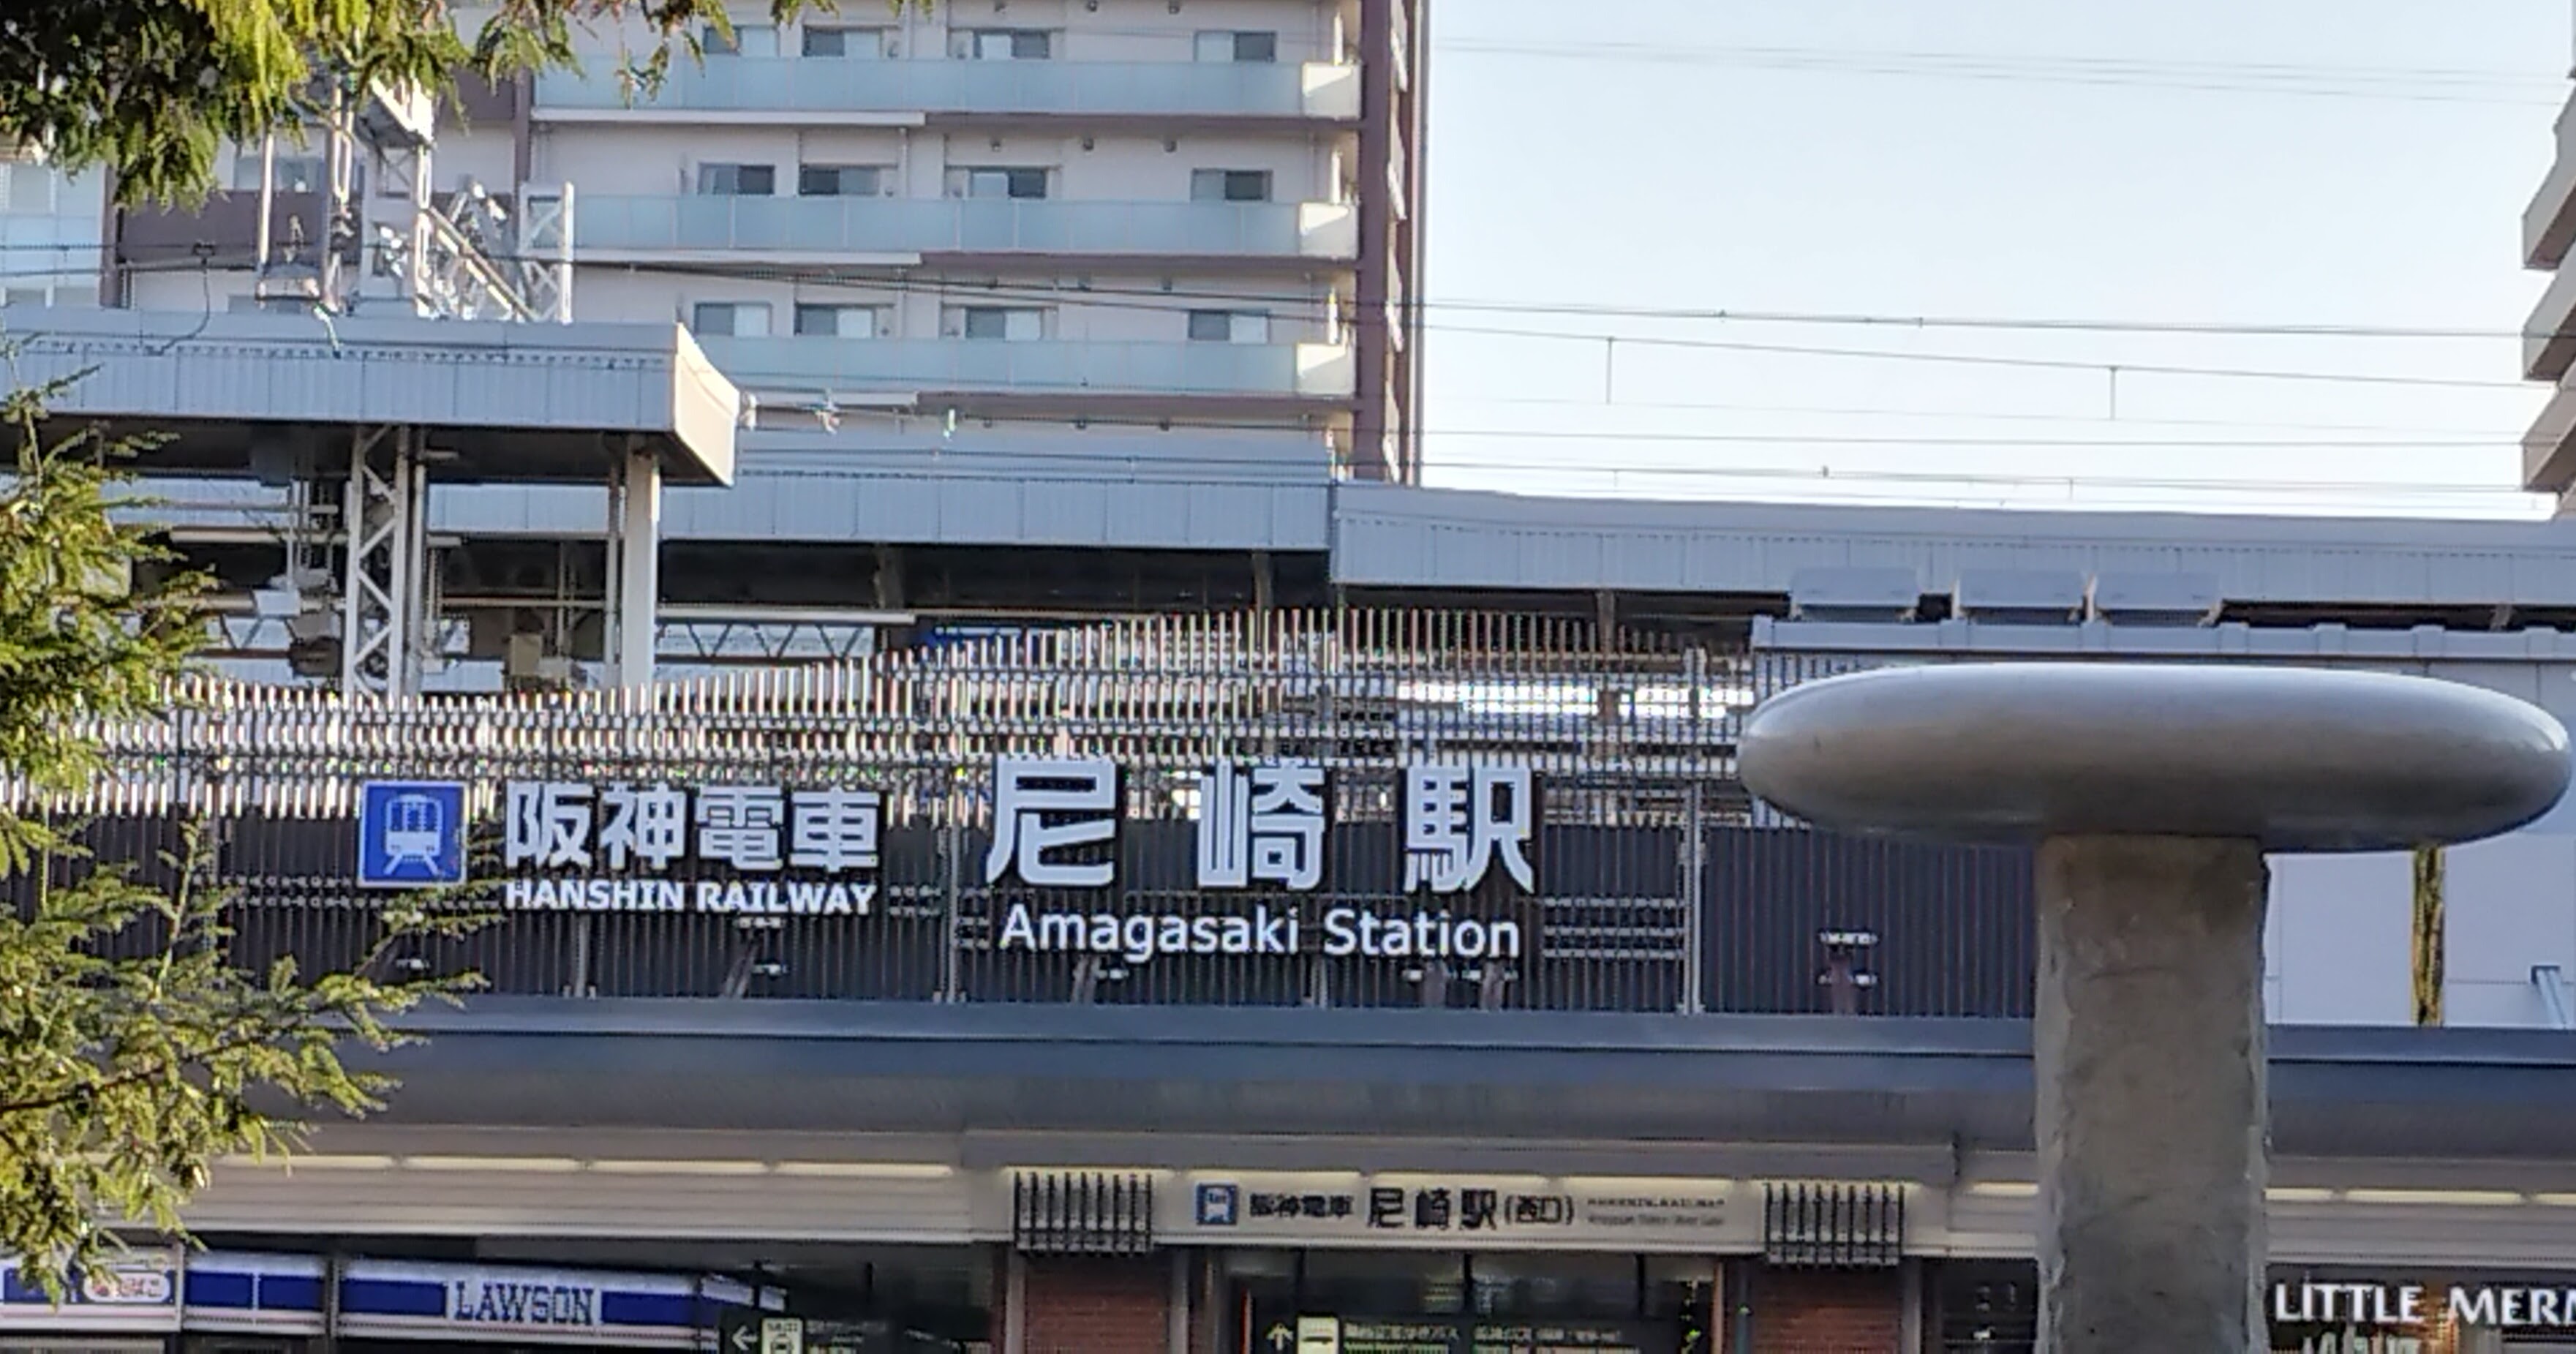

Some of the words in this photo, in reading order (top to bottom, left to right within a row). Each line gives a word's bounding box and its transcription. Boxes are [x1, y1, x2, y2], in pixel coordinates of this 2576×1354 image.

[504, 781, 881, 873] 阪神電車
[986, 756, 1534, 895] 尼崎駅
[505, 879, 685, 912] HANSHIN
[696, 881, 876, 916] RAILWAY
[1000, 903, 1300, 962] Amagasaki
[1324, 908, 1520, 958] Station
[454, 1280, 594, 1326] LAWSON
[2275, 1283, 2425, 1324] LITTLE
[2447, 1286, 2576, 1326] MER
